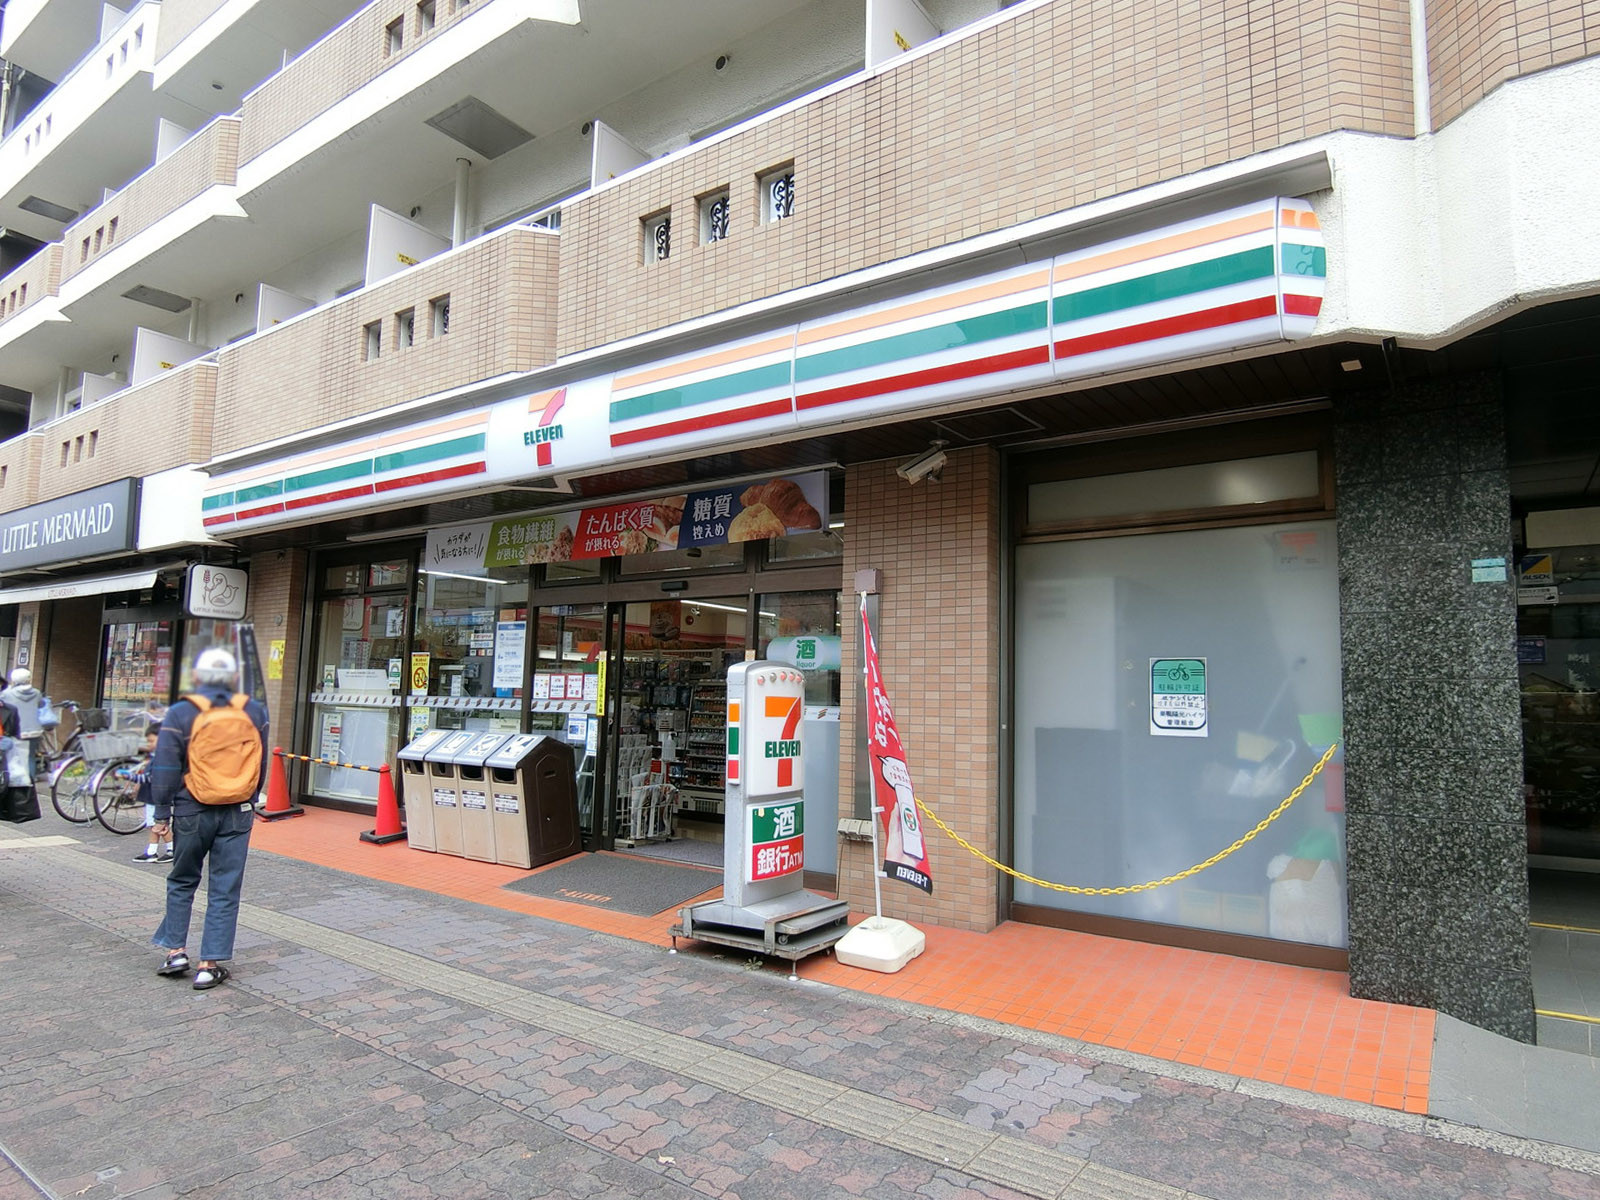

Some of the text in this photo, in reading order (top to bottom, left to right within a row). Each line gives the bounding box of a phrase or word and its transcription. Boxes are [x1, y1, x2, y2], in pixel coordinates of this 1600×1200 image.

[692, 493, 732, 521] 糖質
[2, 502, 115, 554] LITTLE MERMAID
[586, 505, 654, 535] たんぱく質
[497, 519, 555, 546] 食物繊維
[692, 523, 725, 541] 控えめ
[496, 547, 526, 561] が摂れる
[585, 536, 620, 552] が摂れる
[796, 639, 816, 659] 酒
[796, 661, 816, 670] liquor
[773, 806, 795, 838] 酒
